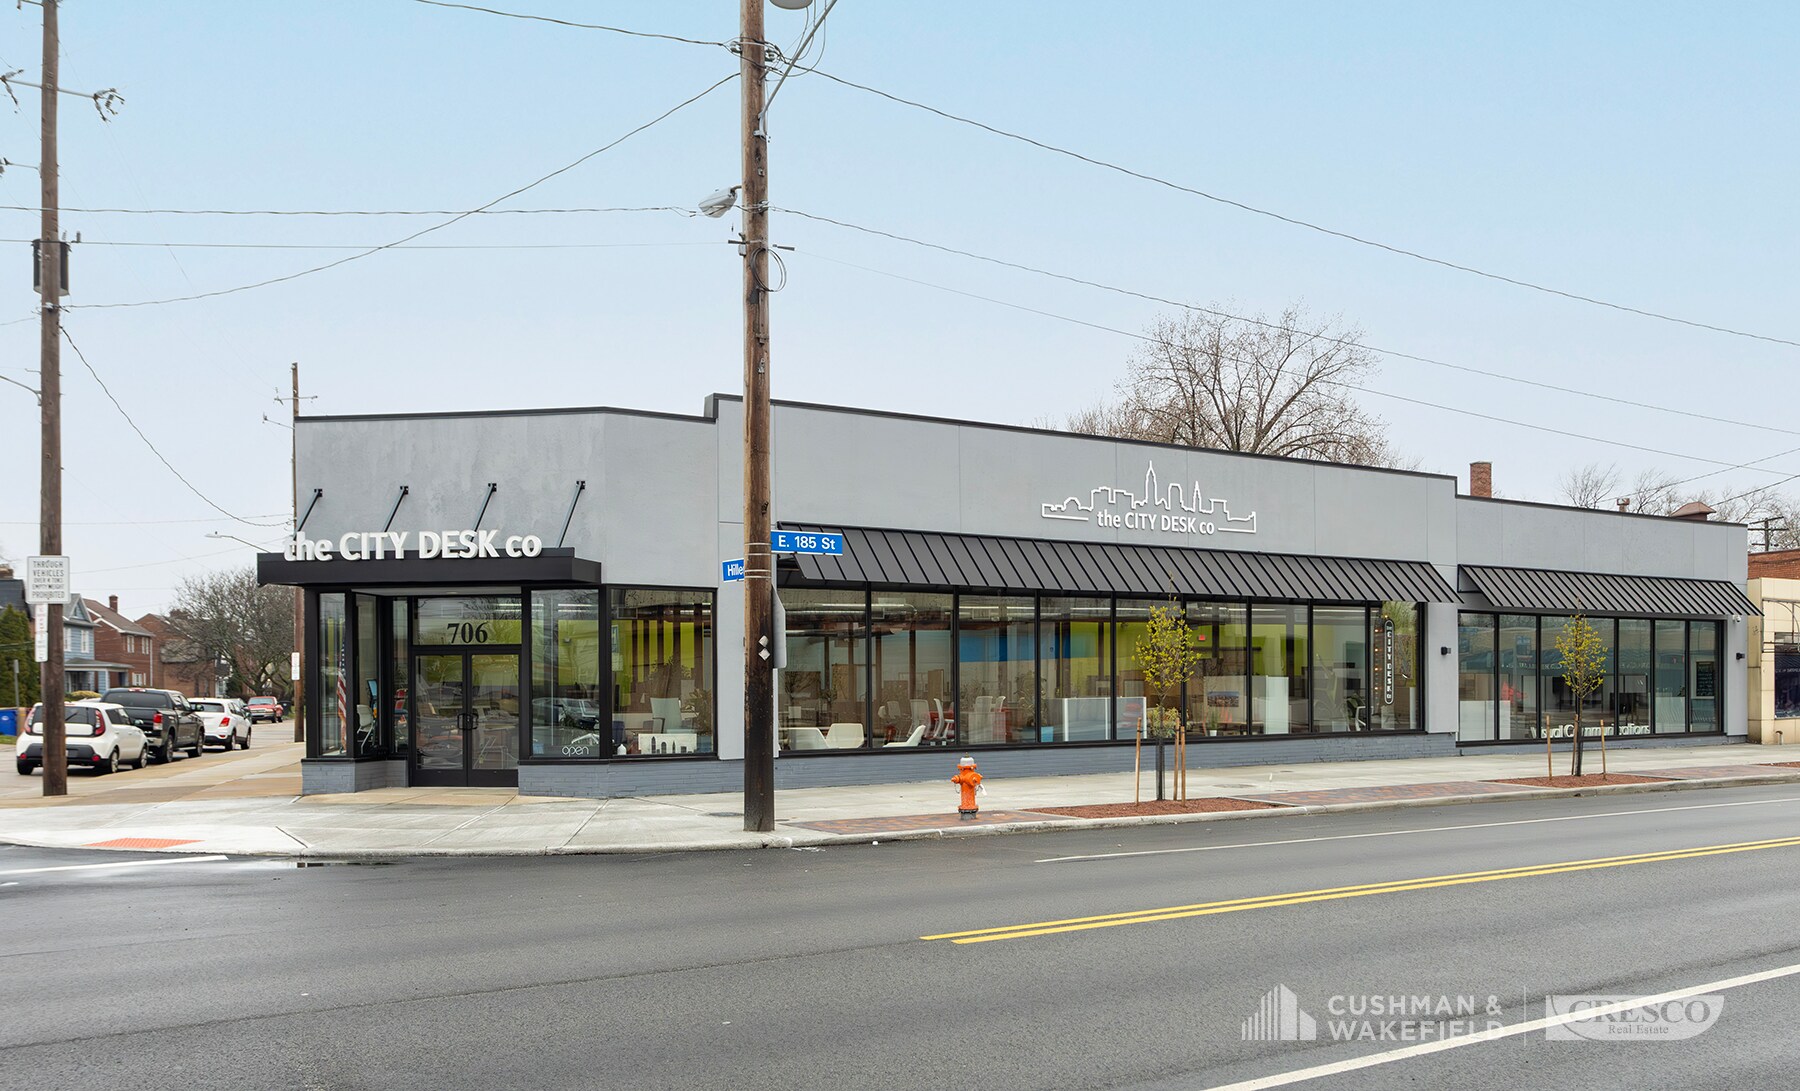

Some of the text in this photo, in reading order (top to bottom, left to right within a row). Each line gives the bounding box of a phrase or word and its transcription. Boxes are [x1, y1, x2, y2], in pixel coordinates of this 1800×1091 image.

[1097, 509, 1214, 534] the CITY DESK co
[284, 529, 542, 561] the CITY DESK co
[778, 535, 836, 550] E. 185 St
[447, 621, 489, 644] 706
[561, 746, 589, 757] open
